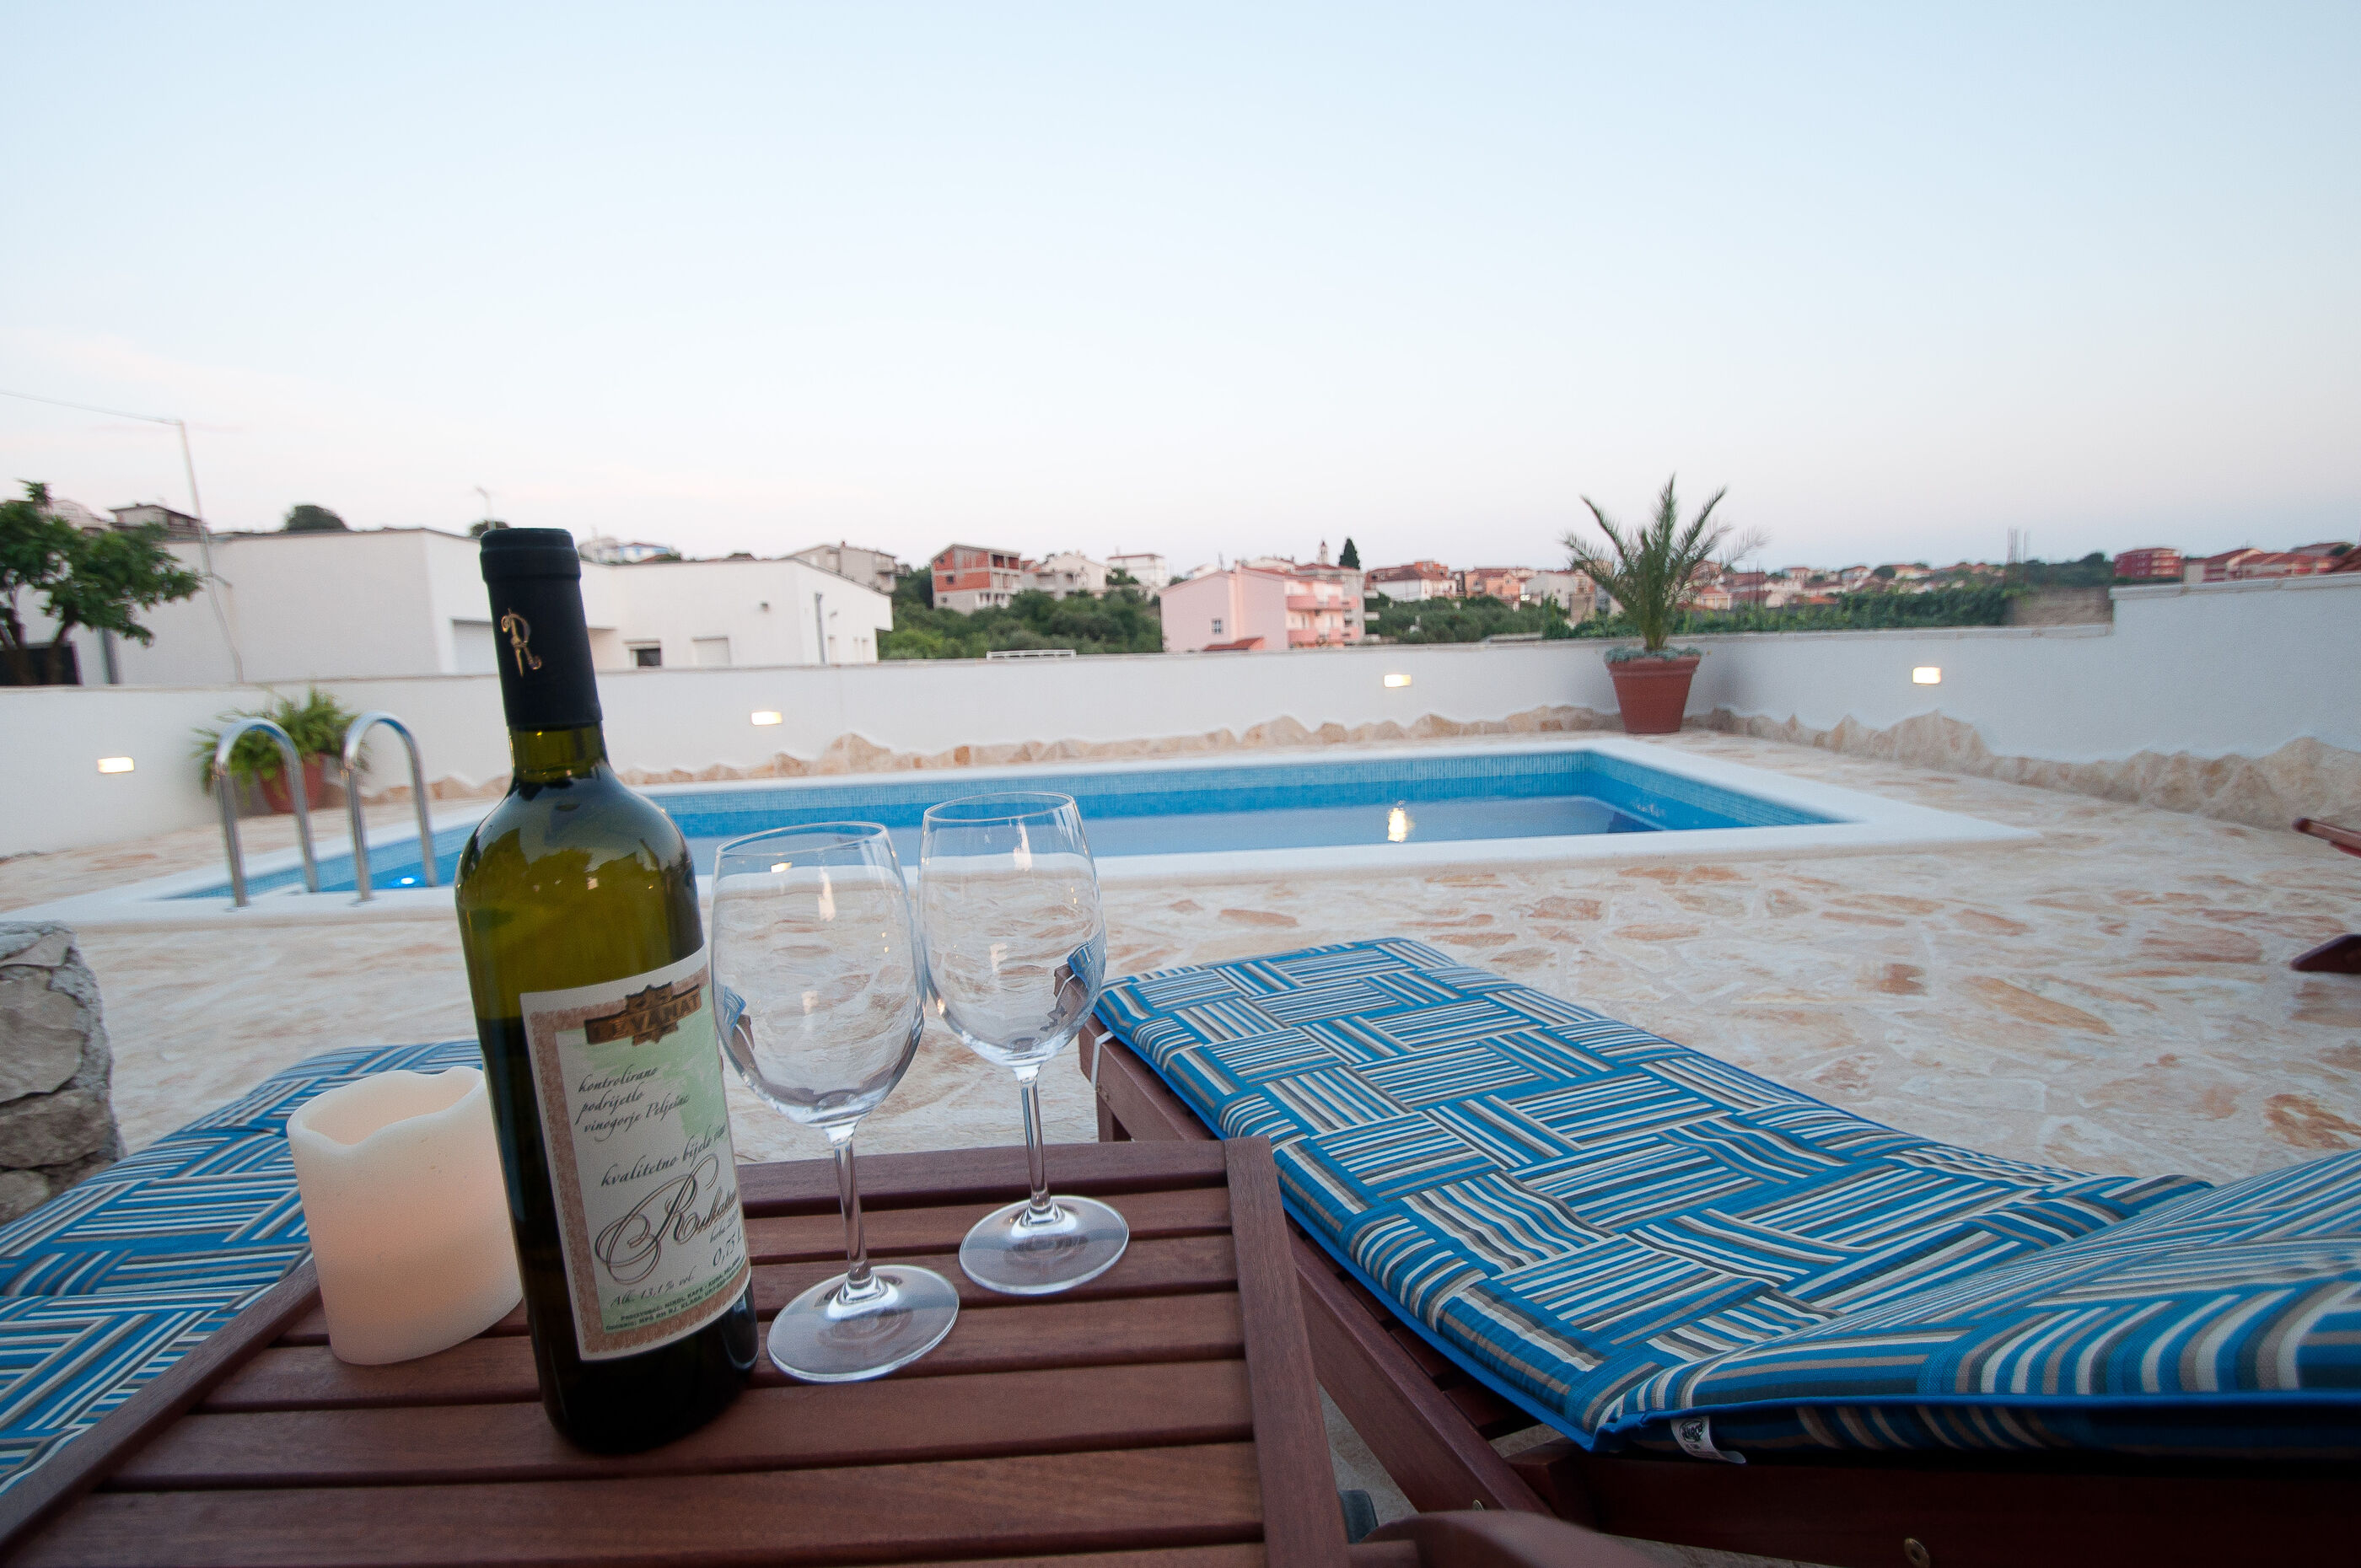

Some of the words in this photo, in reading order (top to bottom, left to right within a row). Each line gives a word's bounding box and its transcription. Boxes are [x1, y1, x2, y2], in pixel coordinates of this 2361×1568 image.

[501, 608, 542, 677] R
[578, 1064, 658, 1093] kontrolirano
[574, 1081, 645, 1125] podrijetlo
[584, 1111, 642, 1142] vinogorje
[601, 1155, 679, 1187] kvalitetno
[683, 1125, 713, 1168] bijelo
